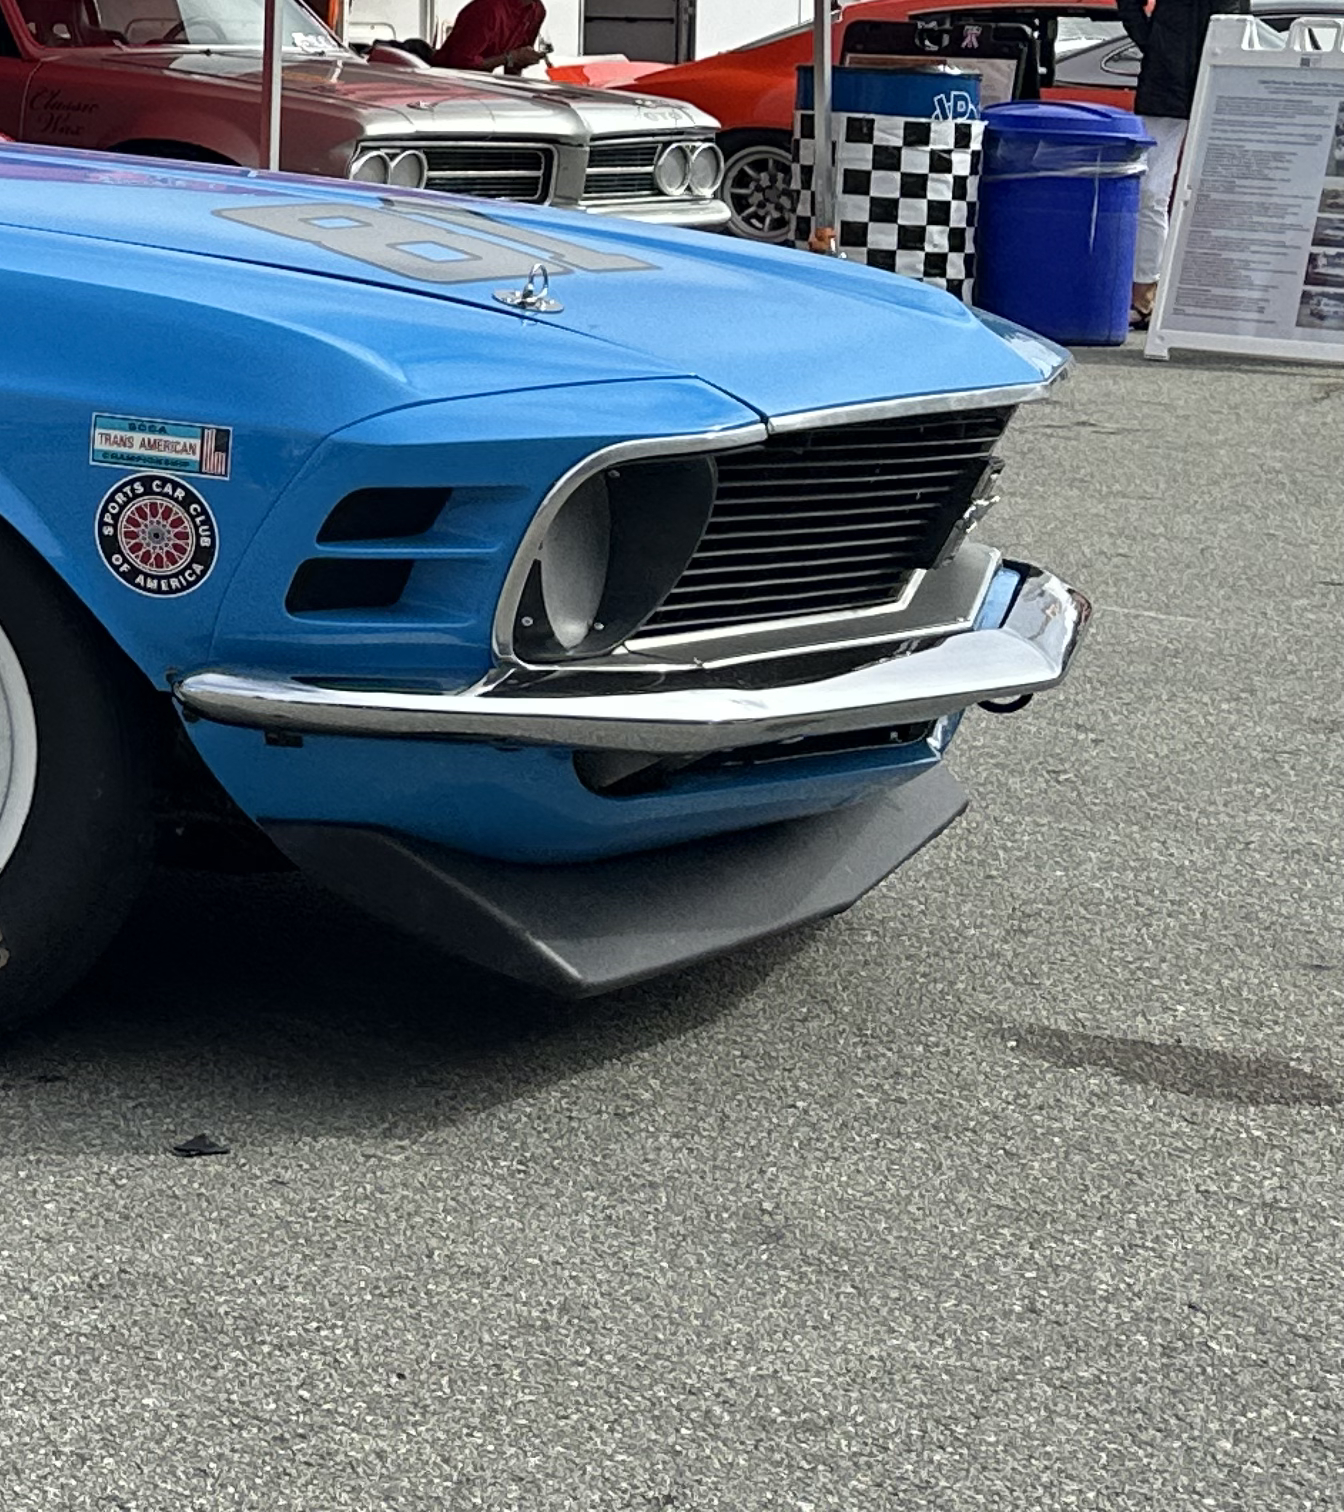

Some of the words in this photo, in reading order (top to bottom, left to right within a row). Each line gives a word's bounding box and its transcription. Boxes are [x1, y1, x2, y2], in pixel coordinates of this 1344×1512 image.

[211, 196, 662, 285] 81
[97, 432, 135, 449] TRANS
[138, 436, 197, 456] AMERICAN
[102, 480, 144, 536] SPORTS
[151, 479, 186, 502] CAR
[189, 503, 212, 548] CLUB
[111, 553, 132, 574] OF
[134, 562, 205, 592] AMERICA
